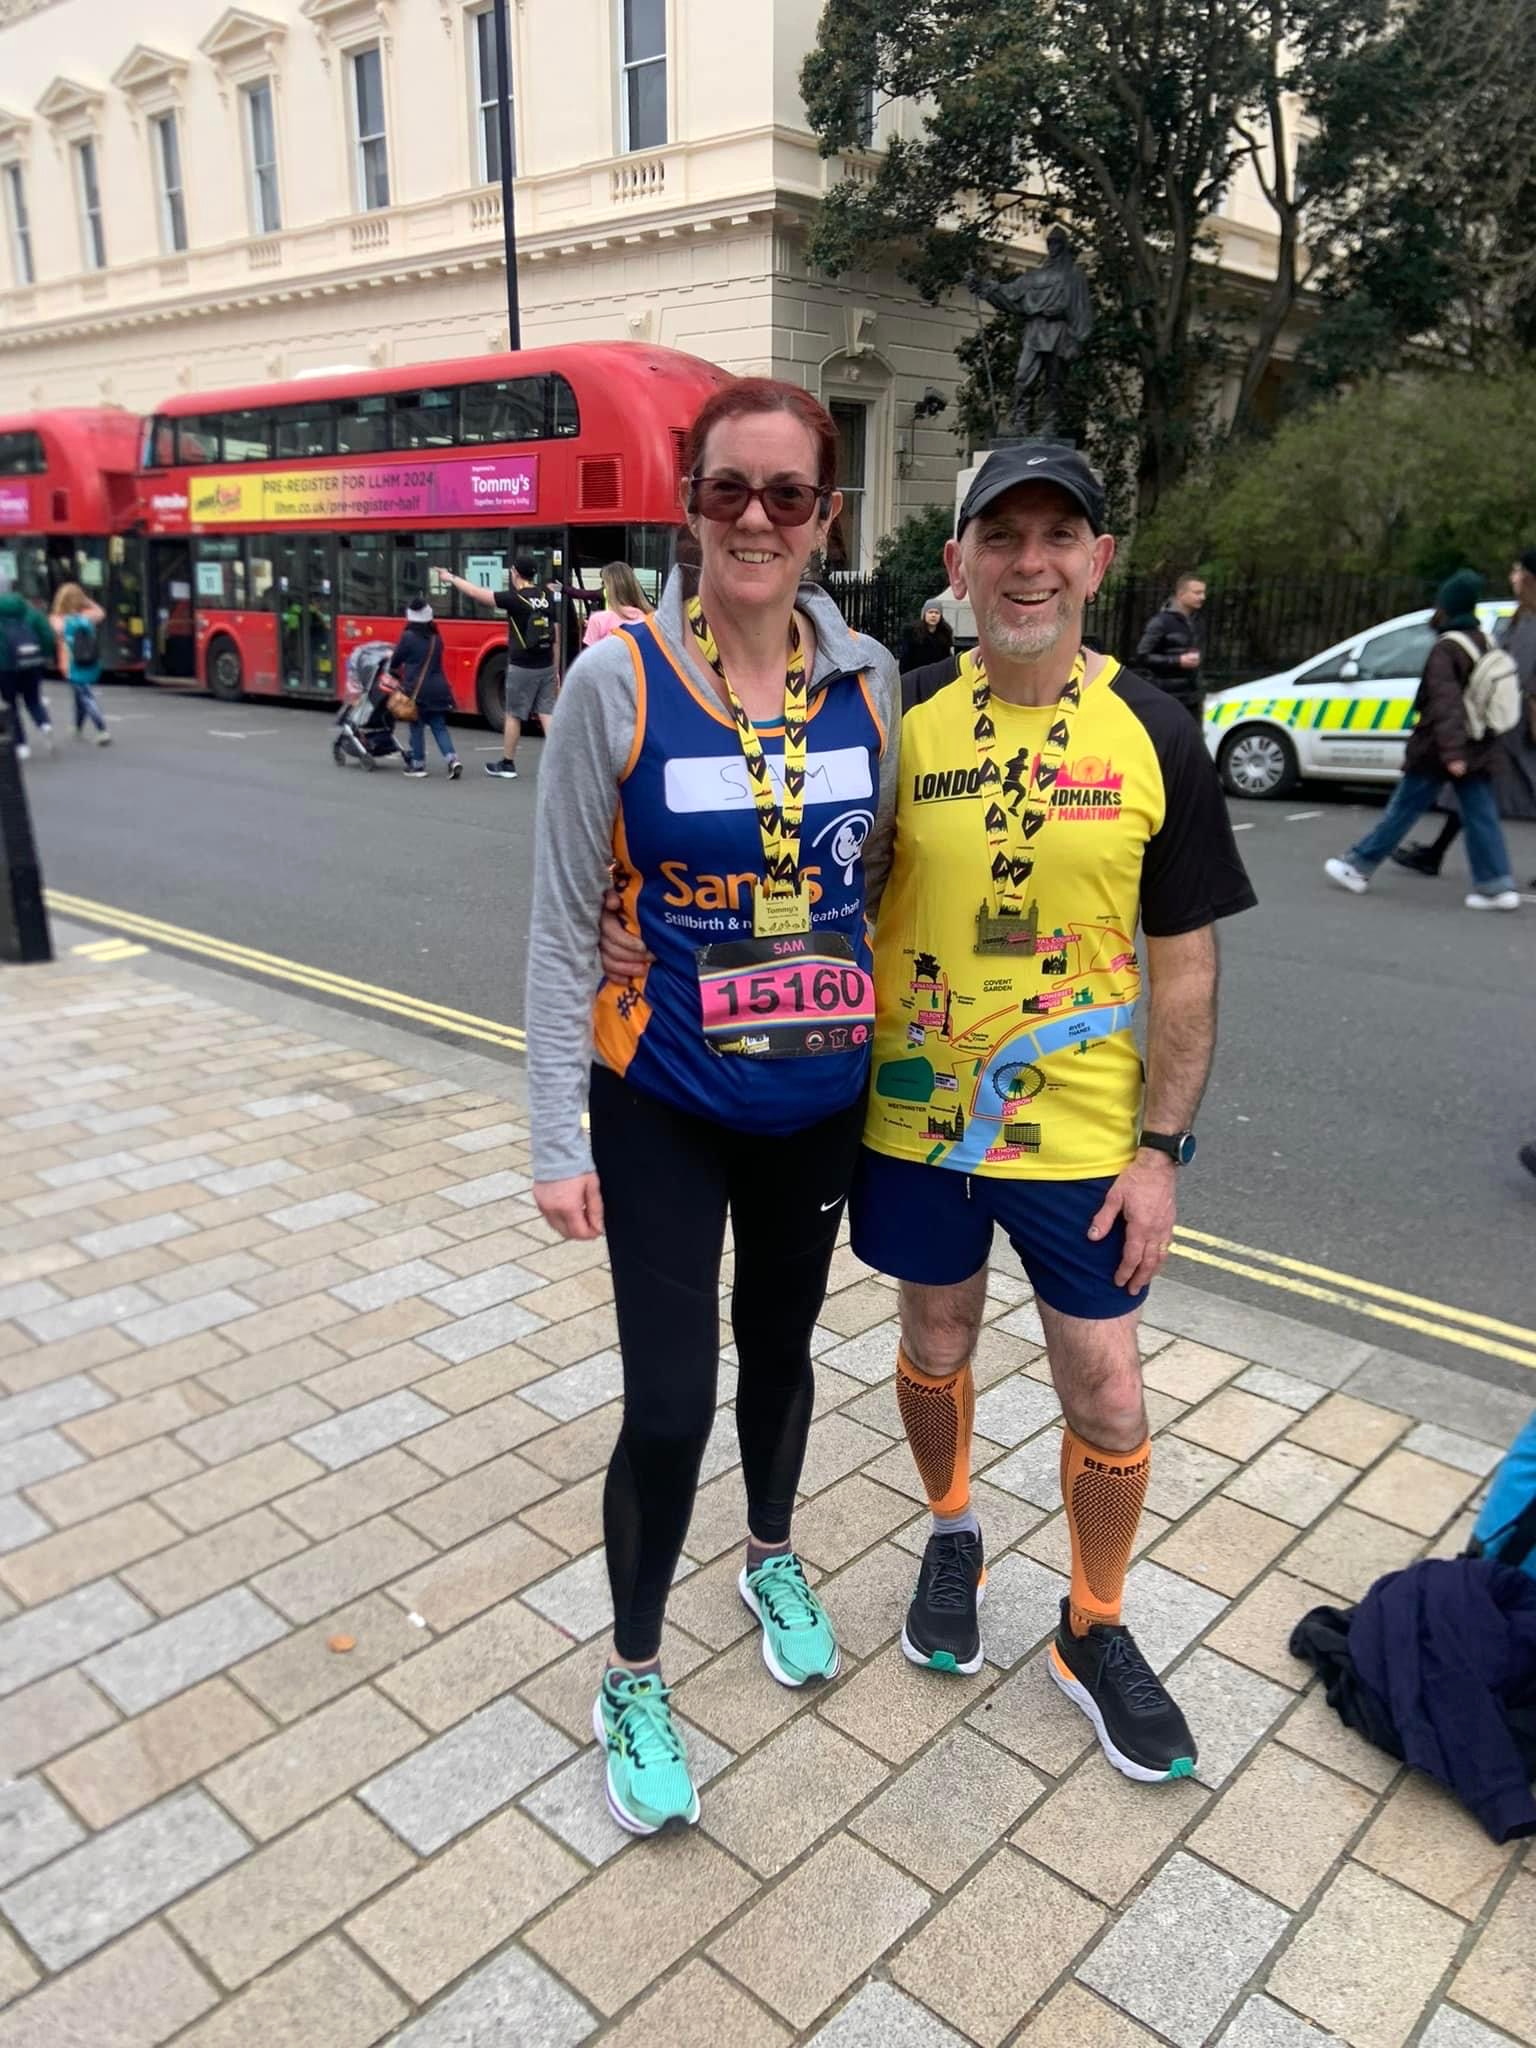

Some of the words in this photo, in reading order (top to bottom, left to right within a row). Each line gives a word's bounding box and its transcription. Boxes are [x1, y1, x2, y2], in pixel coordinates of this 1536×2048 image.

[263, 476, 339, 493] PRE-REGISTER
[342, 475, 366, 489] FOR
[369, 473, 400, 488] LLHM
[404, 471, 434, 487] 2024
[471, 474, 530, 495] Tommy's
[913, 767, 980, 802] LONDO
[1049, 788, 1122, 806] NDMARKS
[1058, 807, 1121, 821] MARATHON
[659, 859, 824, 910] Sans
[766, 905, 799, 915] Tommy's
[663, 911, 724, 931] Stillbirth
[727, 917, 741, 930] &
[773, 939, 806, 955] SAM
[717, 968, 865, 1017] 15160
